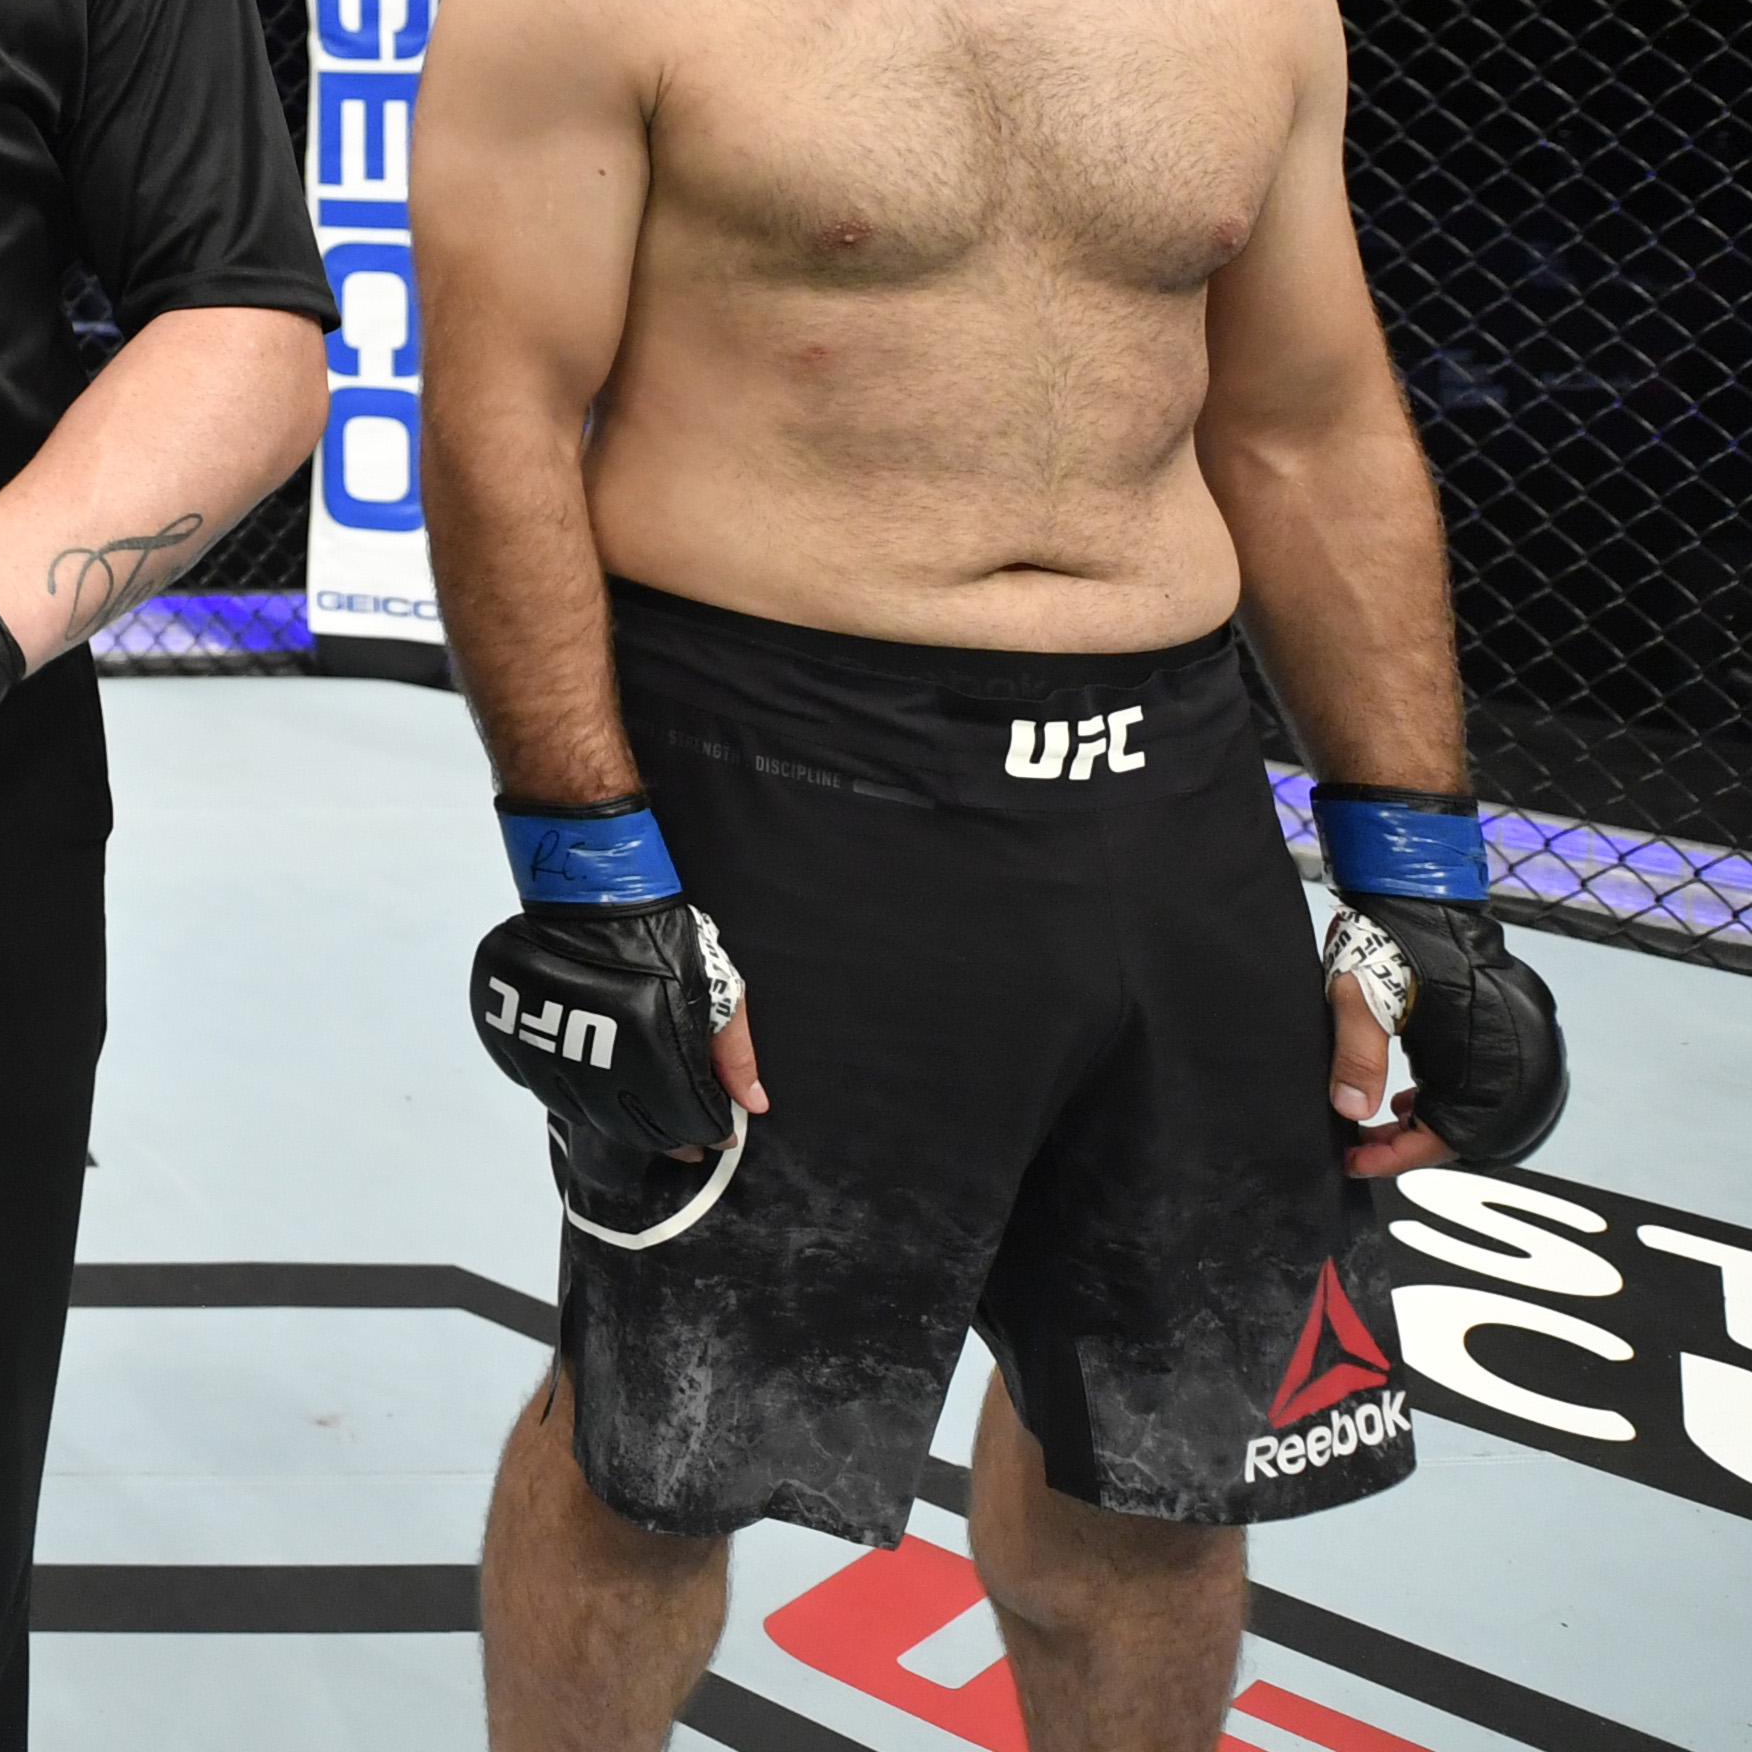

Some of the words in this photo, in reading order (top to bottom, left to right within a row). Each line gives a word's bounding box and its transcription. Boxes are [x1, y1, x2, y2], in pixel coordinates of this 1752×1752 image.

[316, 589, 439, 622] GEICO
[754, 753, 844, 789] DISCIPLINE
[1004, 704, 1146, 781] UFC
[485, 975, 619, 1070] UFC
[1244, 1390, 1413, 1484] Reebok
